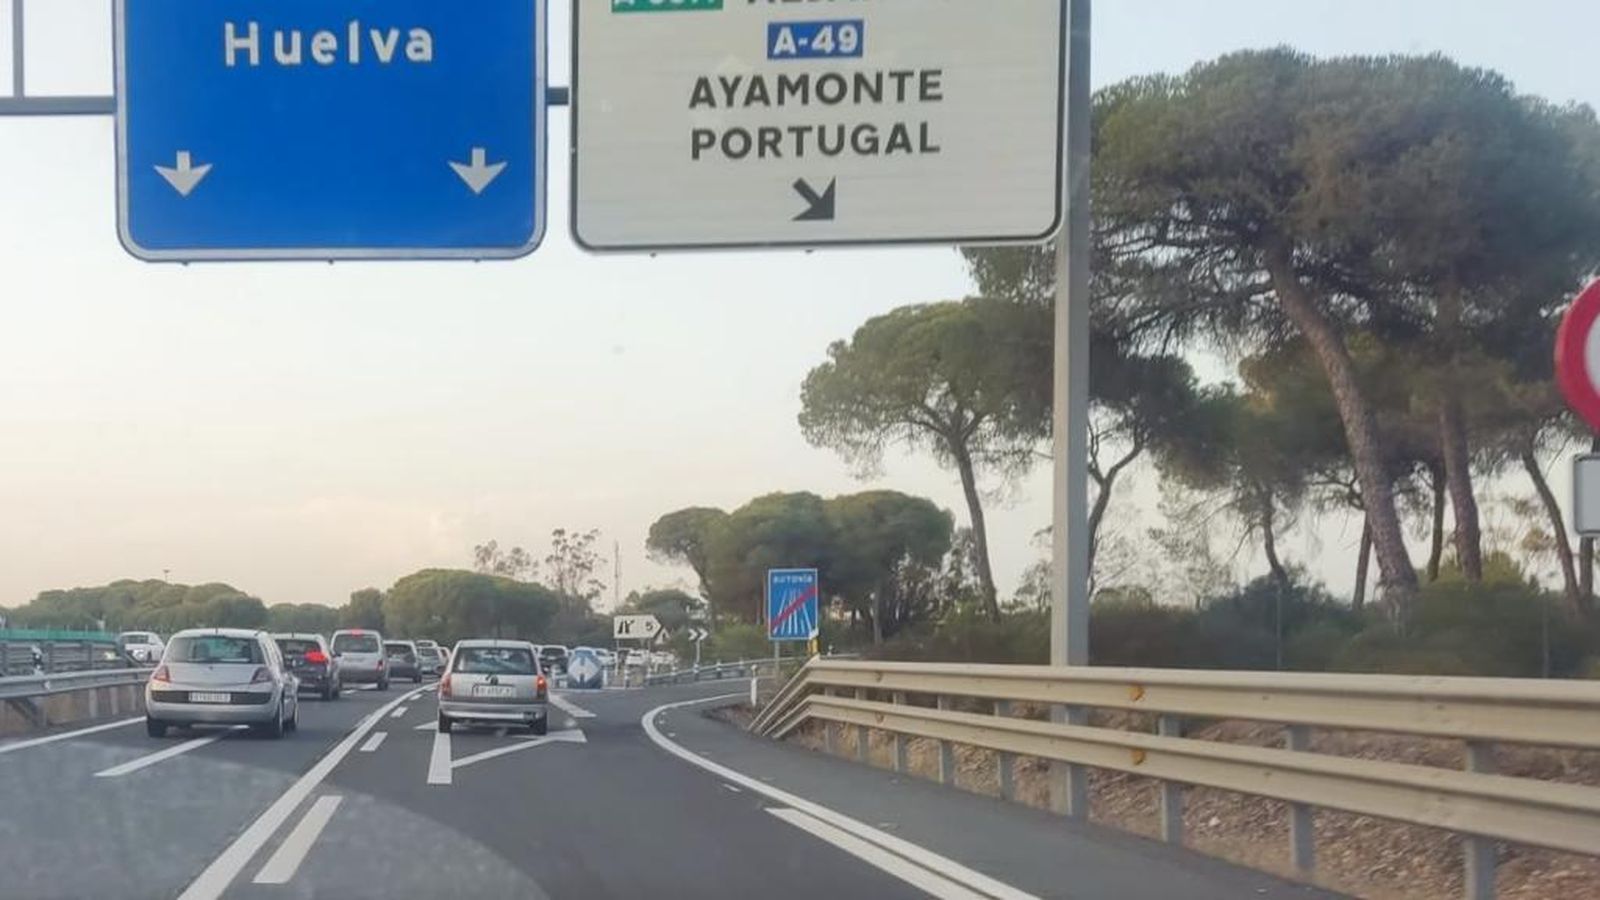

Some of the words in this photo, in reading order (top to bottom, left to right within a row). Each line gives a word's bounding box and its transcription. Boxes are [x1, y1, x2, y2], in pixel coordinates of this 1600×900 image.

[225, 21, 433, 66] Huelva
[772, 24, 860, 56] A-49
[689, 69, 943, 108] AYAMONTE
[691, 122, 941, 160] PORTUGAL
